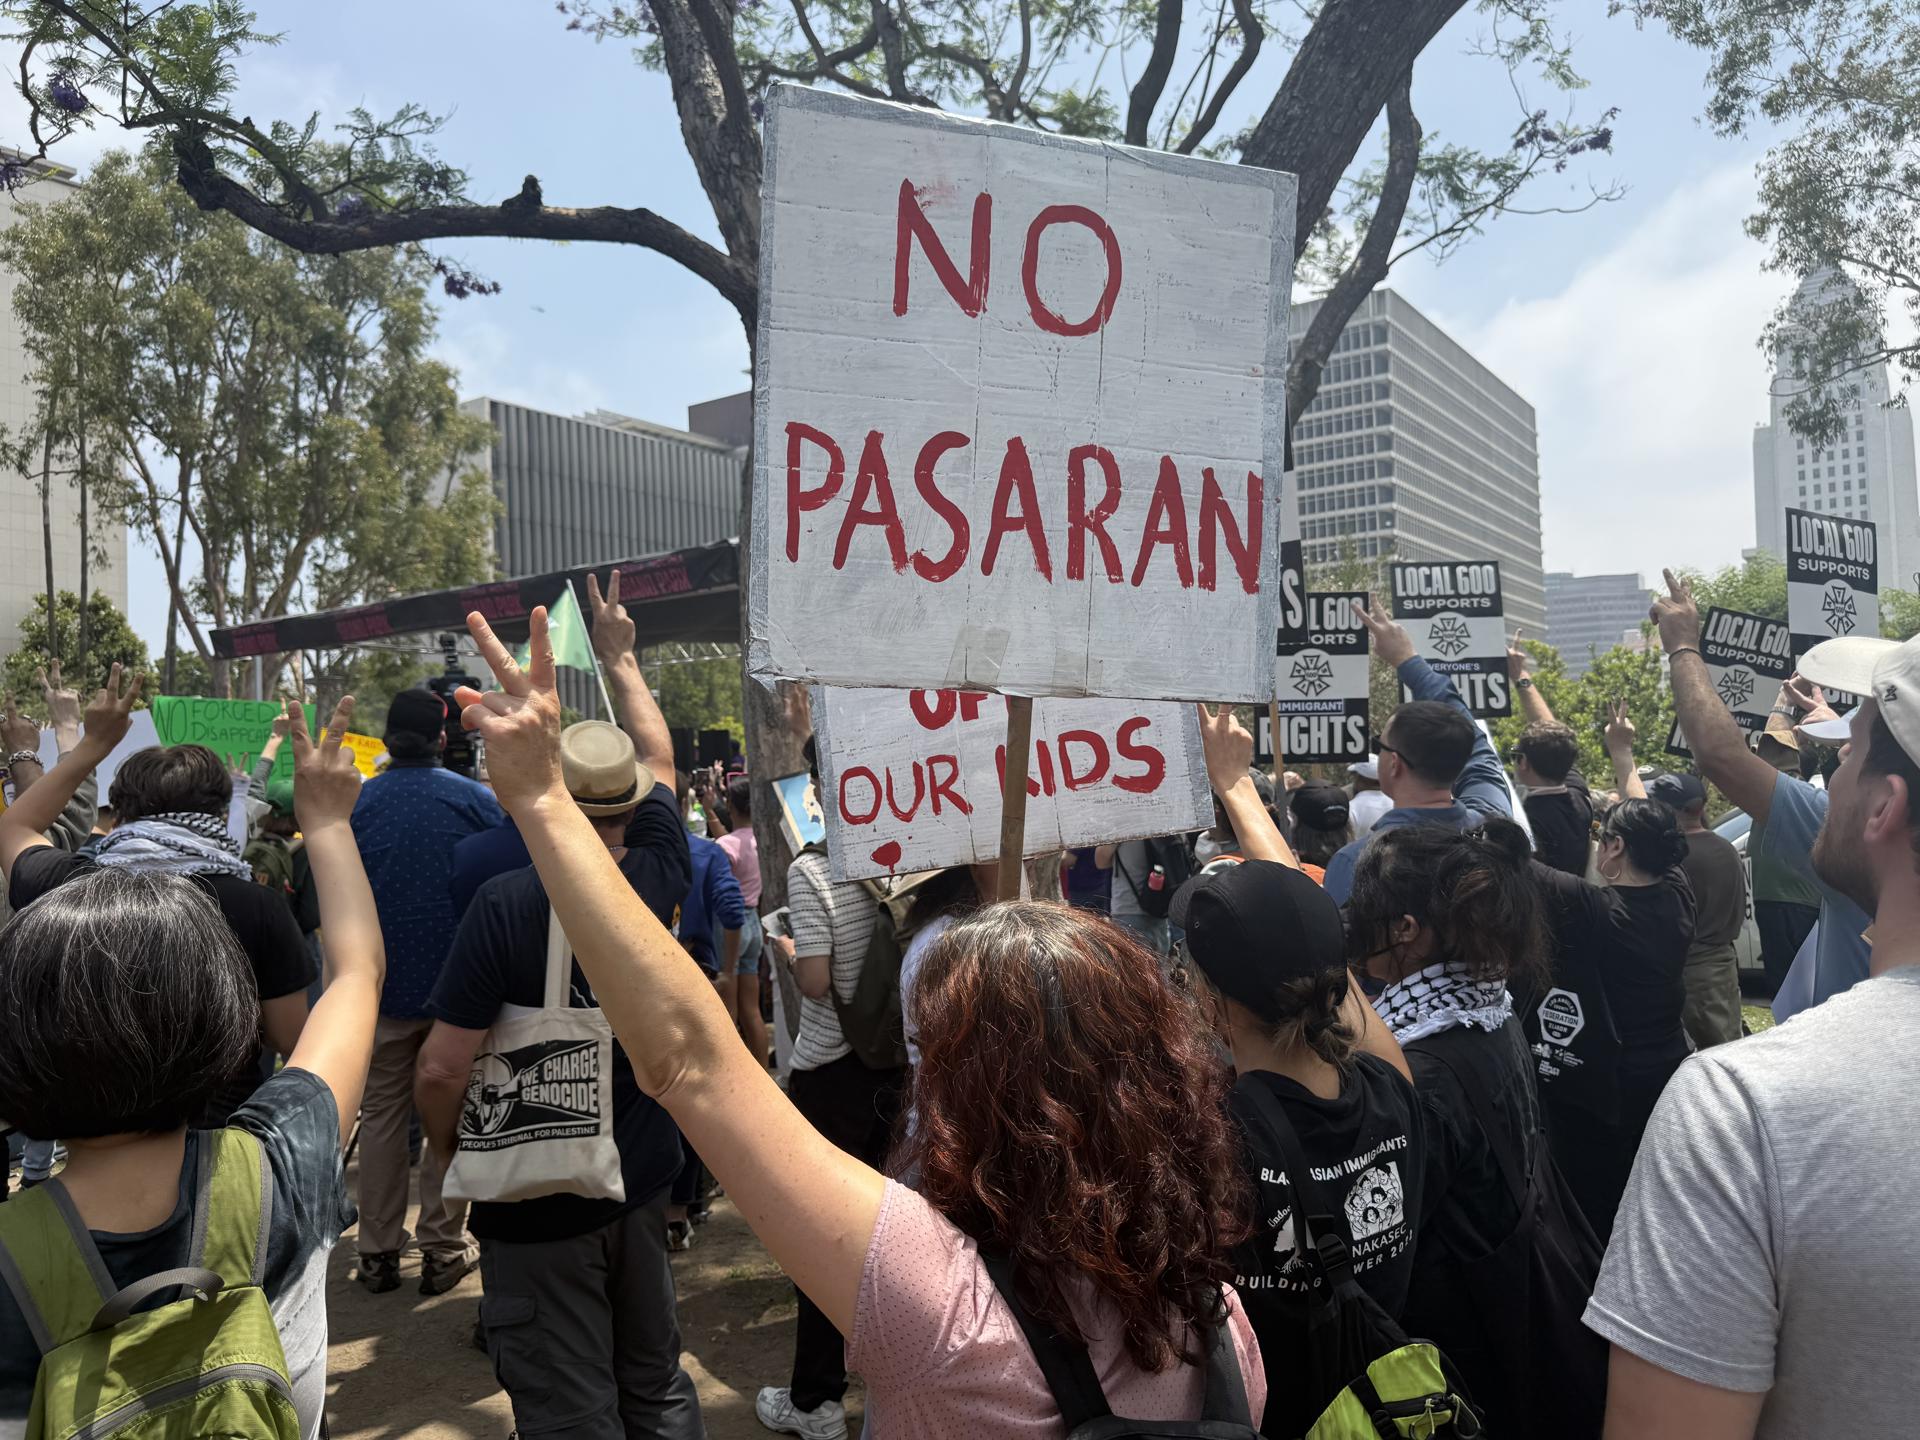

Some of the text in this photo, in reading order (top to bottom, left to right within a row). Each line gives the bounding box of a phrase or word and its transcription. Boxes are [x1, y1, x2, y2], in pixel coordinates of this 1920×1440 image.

[892, 178, 1122, 337] NO
[785, 421, 1263, 594] PASARAN
[1791, 514, 1874, 565] LOCAL 600
[1395, 564, 1496, 597] LOCAL 600
[1797, 558, 1870, 580] SUPPORTS
[1323, 597, 1364, 630] 600
[1403, 597, 1492, 610] SUPPORTS
[1310, 633, 1357, 645] ORTS
[1705, 611, 1762, 650] LOCAL
[1429, 663, 1480, 671] VERYONE'S
[1706, 644, 1785, 670] SUPPORTS
[154, 697, 275, 744] NO FORCED
[1278, 701, 1343, 712] IMMIGRANT
[1259, 715, 1365, 755] RIGHTS
[839, 754, 973, 825] OUR
[521, 1046, 598, 1086] WE CHARGE
[521, 1081, 599, 1113] GENOCIDE
[534, 1128, 551, 1138] FOR
[551, 1126, 595, 1136] PALESTINE
[1352, 1222, 1407, 1258] NAKASEC
